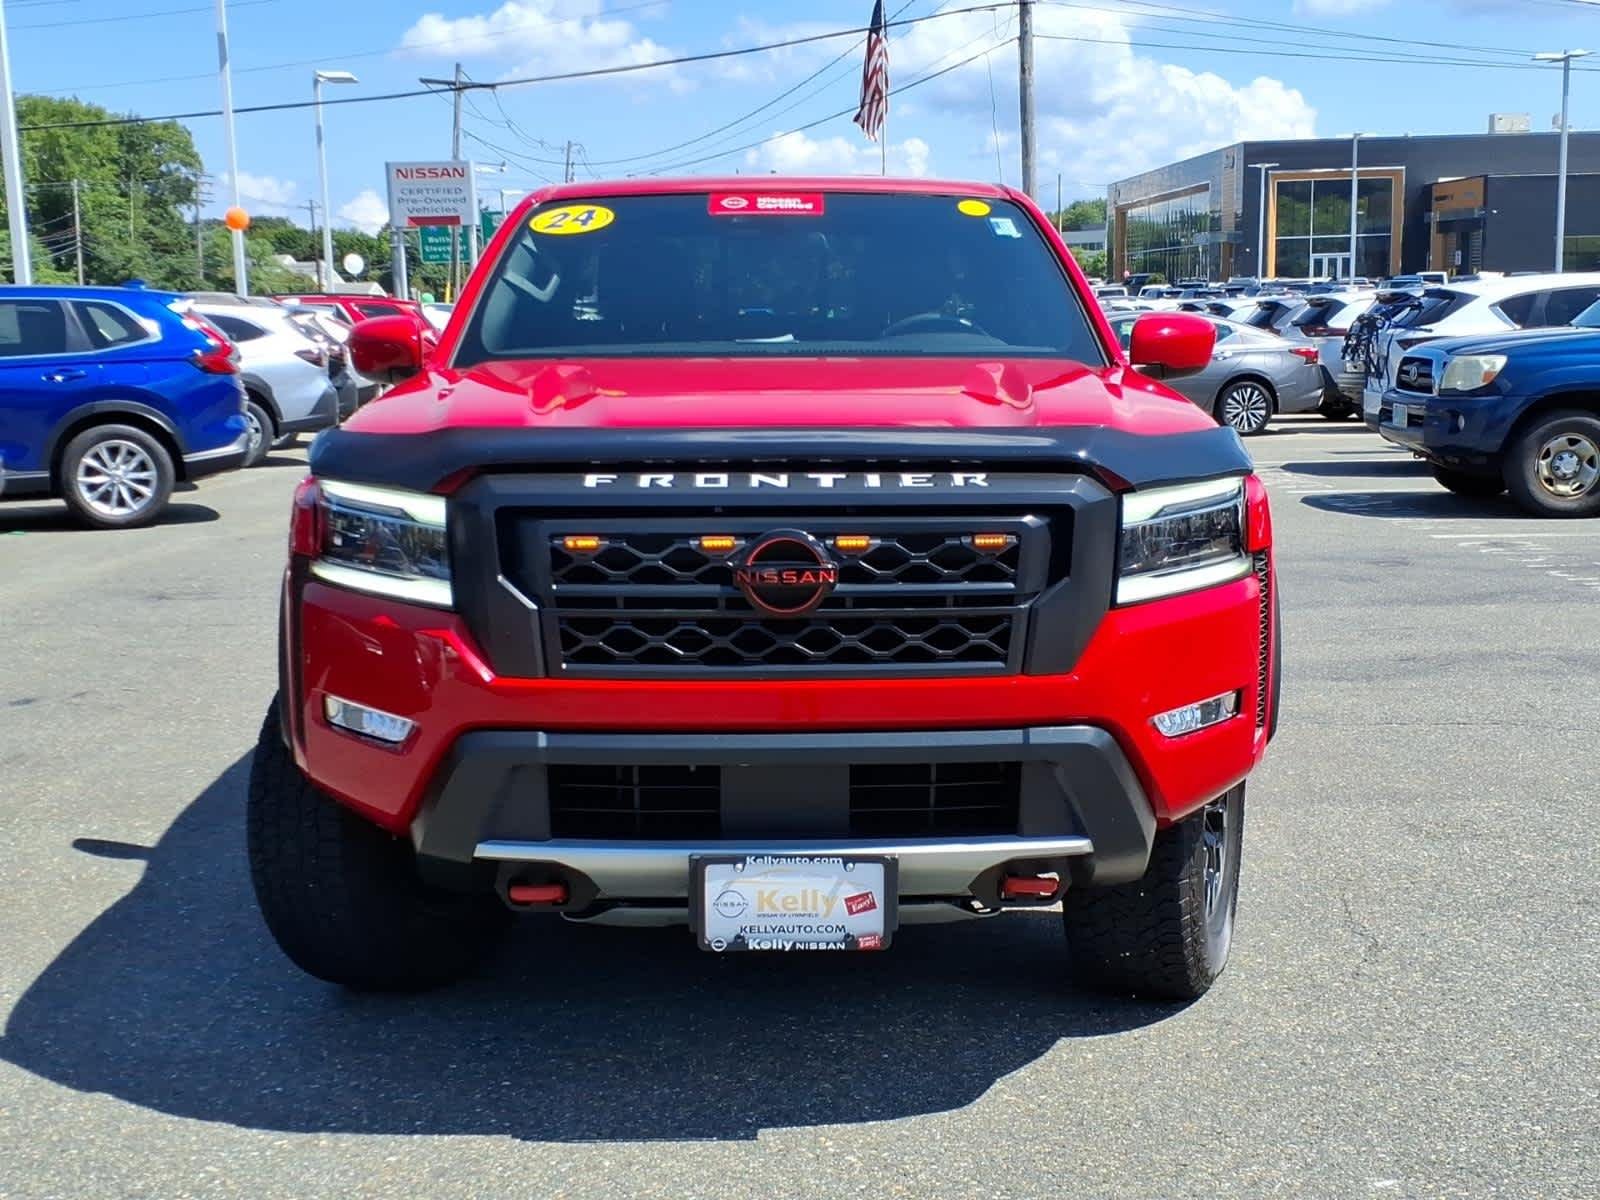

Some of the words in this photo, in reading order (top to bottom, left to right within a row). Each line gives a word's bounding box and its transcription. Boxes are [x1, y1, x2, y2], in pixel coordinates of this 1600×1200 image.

[396, 167, 465, 179] NISSAN
[400, 186, 463, 196] CERTIFIED
[407, 206, 459, 214] Vehicles
[544, 209, 596, 229] 24
[584, 473, 989, 488] FRONTIER
[736, 570, 835, 585] NISSAN
[746, 855, 843, 866] Kellyauto.com
[756, 890, 838, 919] Kelly
[740, 924, 846, 935] KELLYAUTO.COM
[748, 937, 794, 951] Kelly
[796, 942, 845, 950] NISSAN
